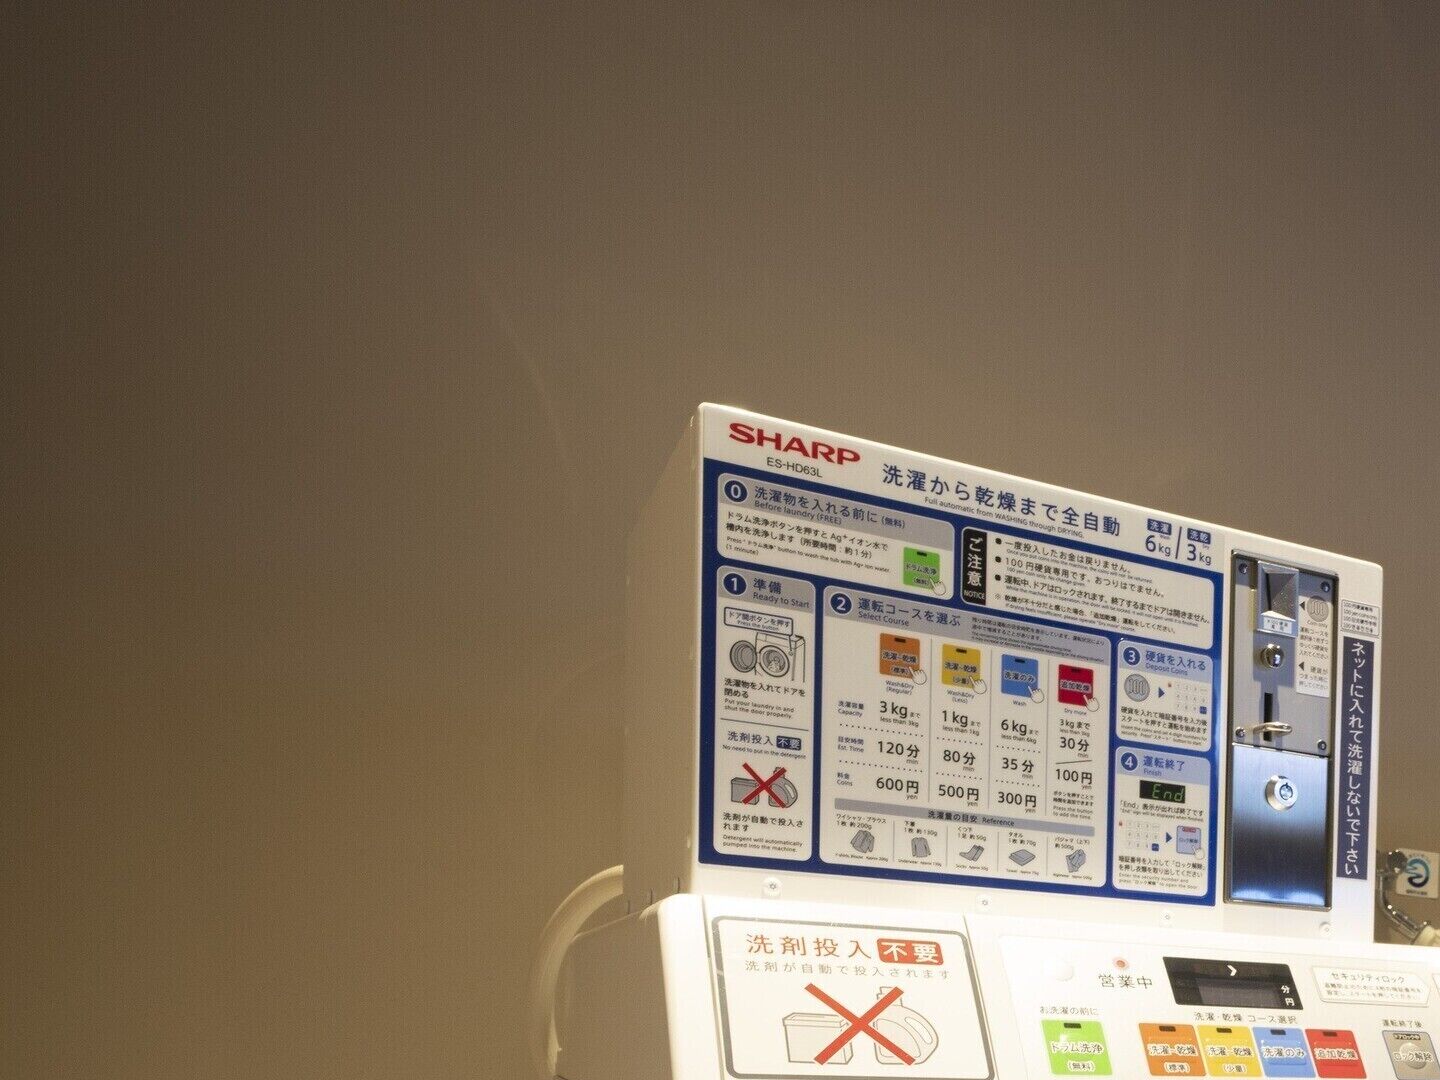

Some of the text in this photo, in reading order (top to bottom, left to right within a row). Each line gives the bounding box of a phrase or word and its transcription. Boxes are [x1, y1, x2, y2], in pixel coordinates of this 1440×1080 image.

[729, 422, 861, 465] SHARP
[766, 457, 823, 478] ES-HD63L
[754, 485, 877, 523] 洗濯物を入れる前に
[882, 463, 1120, 536] 洗濯から乾燥まで全自動
[754, 500, 842, 525] Before laundry (FREE)
[924, 496, 937, 506] Full
[939, 499, 975, 514] automatic
[976, 508, 994, 518] from
[994, 512, 1028, 526] WASHING
[967, 536, 982, 587] ご注意
[752, 593, 810, 609] Ready to Start
[964, 590, 986, 600] NOTICE
[858, 598, 961, 627] 運転コースを選ぶ
[858, 612, 910, 627] Select Course
[728, 731, 773, 746] 洗剤投入
[1143, 755, 1185, 771] 運転終了
[1345, 642, 1366, 876] ネットに入れて洗濯しないで下さい
[1152, 783, 1184, 802] End
[982, 816, 1015, 827] Reference
[746, 933, 940, 964] 洗剤投入 不要
[745, 959, 951, 980] 洗剤が自動で投入されます
[1098, 973, 1153, 990] 営業中
